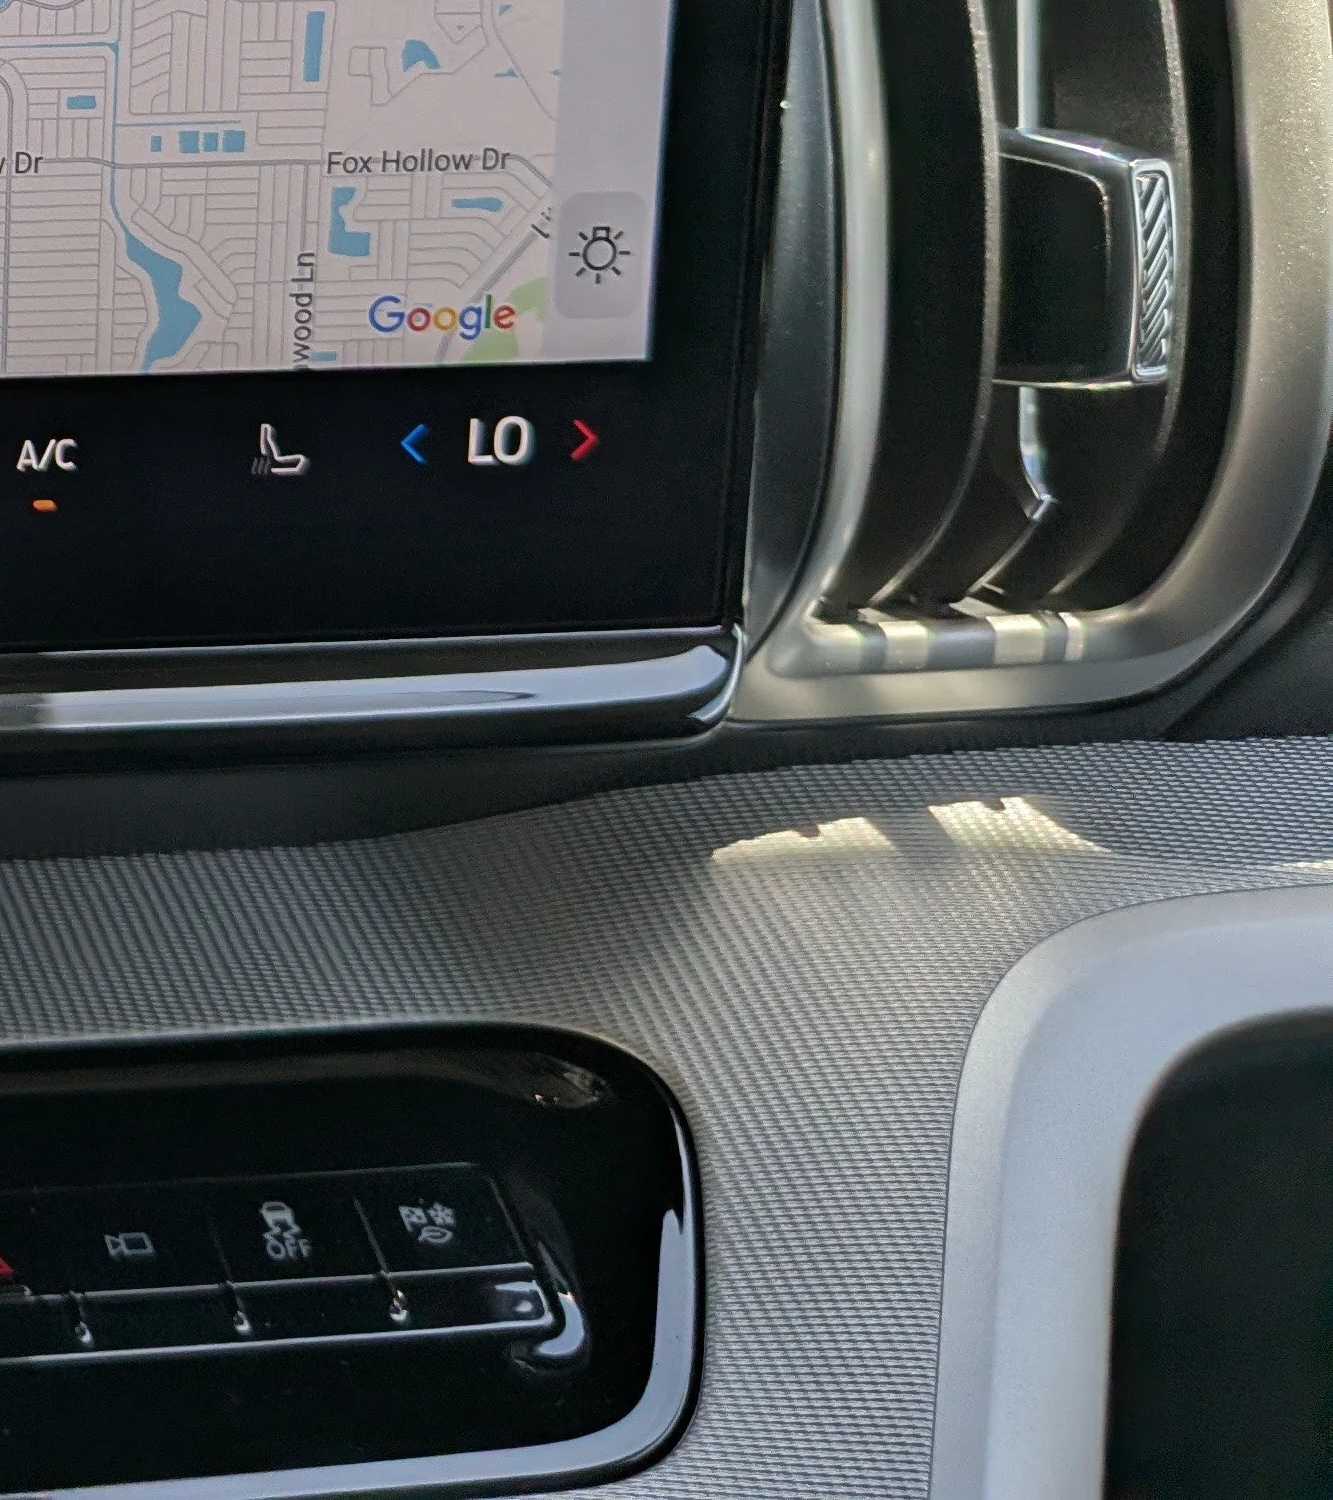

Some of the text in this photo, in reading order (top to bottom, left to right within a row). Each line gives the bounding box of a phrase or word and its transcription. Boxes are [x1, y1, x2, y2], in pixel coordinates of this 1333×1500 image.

[13, 151, 45, 175] Dr
[326, 147, 511, 175] Fox Hollow Dr
[291, 251, 316, 284] Ln
[367, 293, 517, 341] Google
[15, 436, 79, 473] A/C
[466, 415, 533, 466] LO
[265, 1237, 312, 1261] OFF
